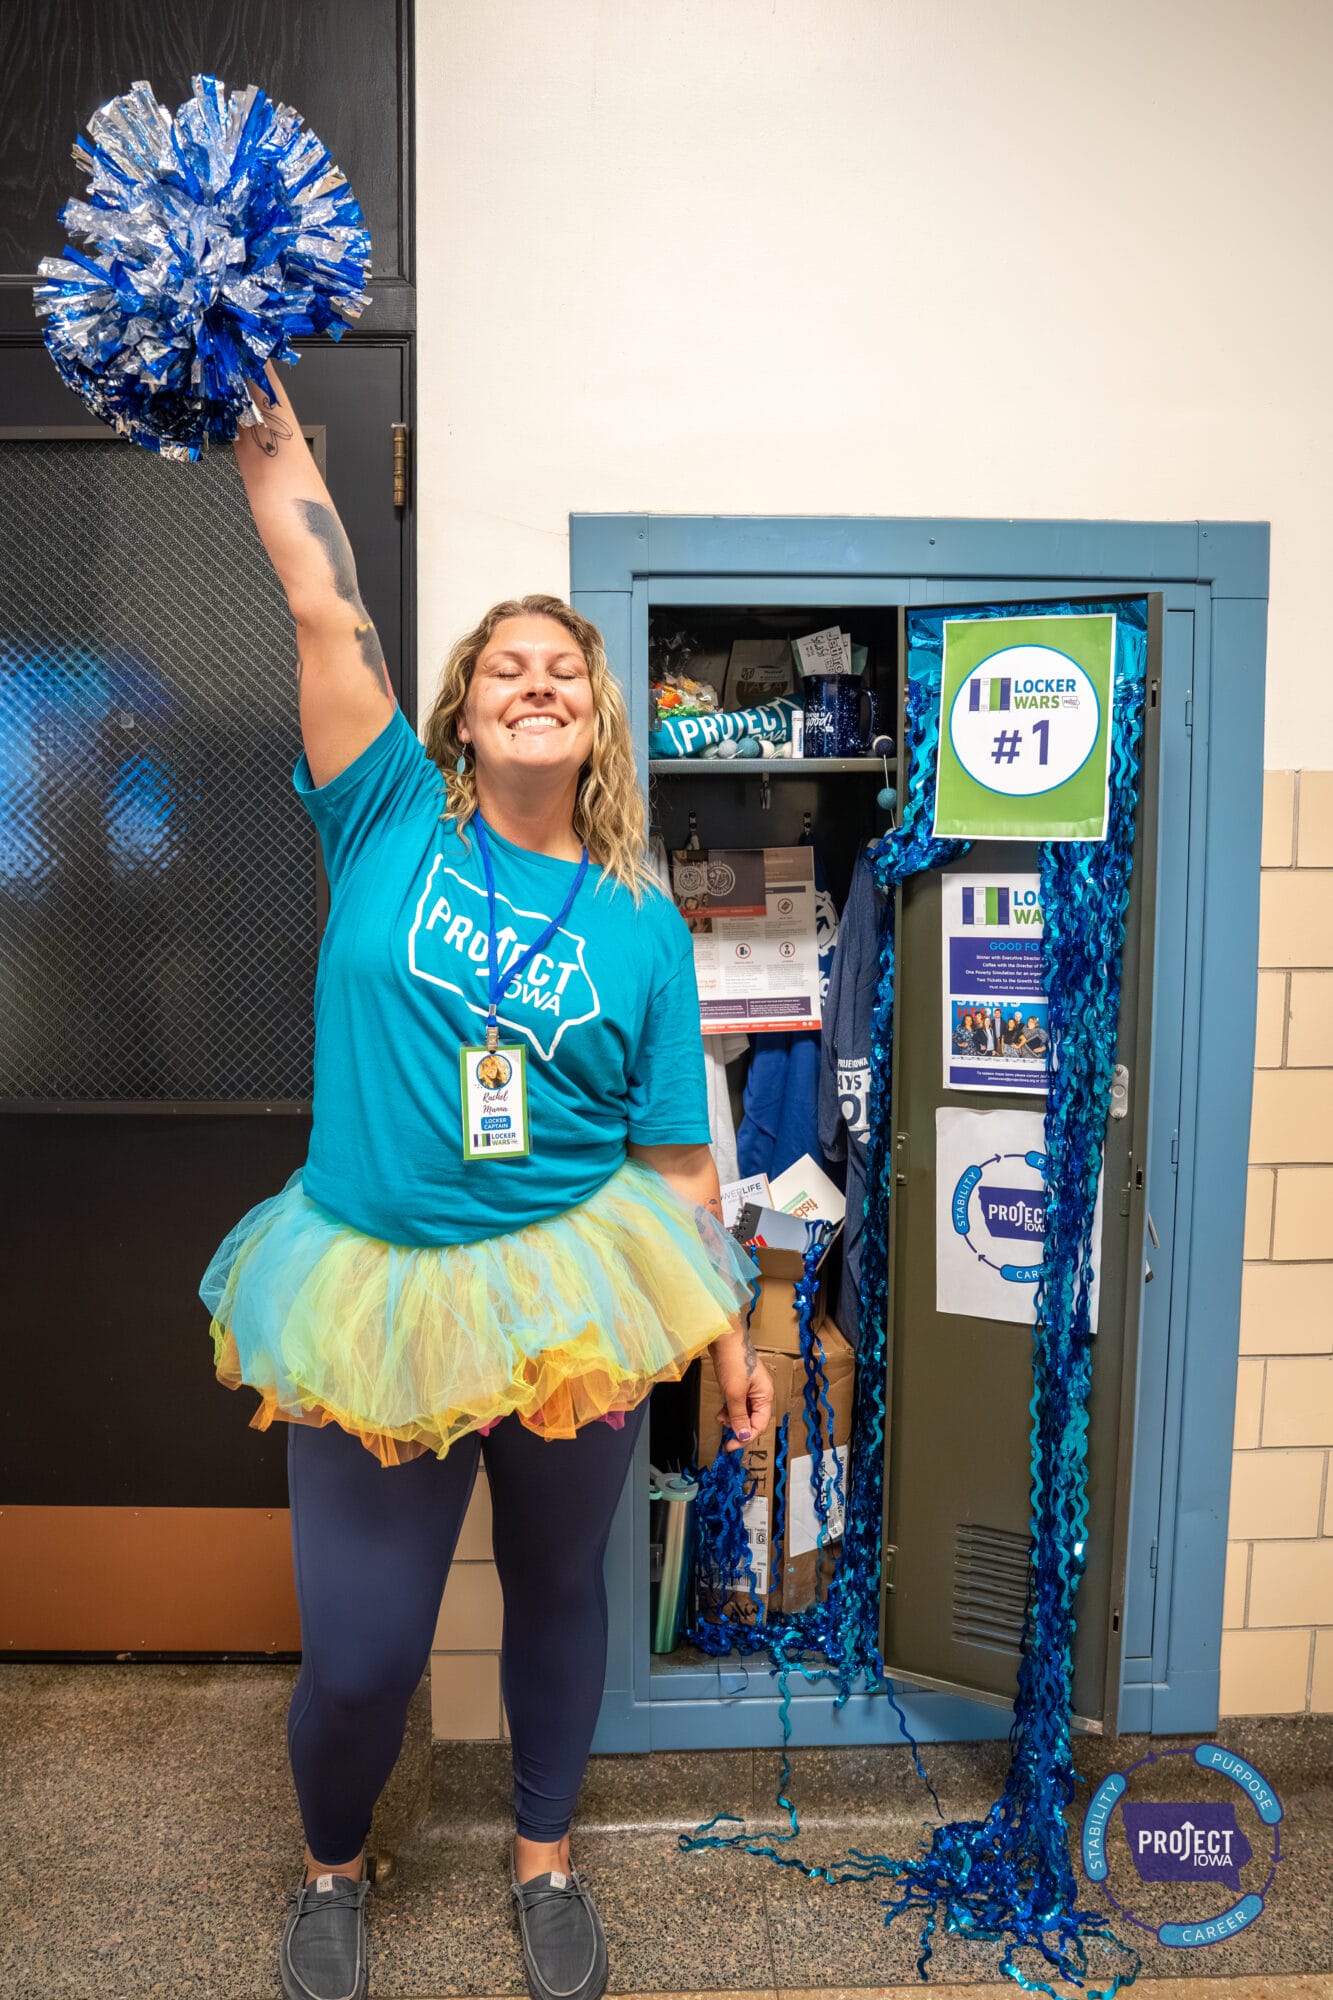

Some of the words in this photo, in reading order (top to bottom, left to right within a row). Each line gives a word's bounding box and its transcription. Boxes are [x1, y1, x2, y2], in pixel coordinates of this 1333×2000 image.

[1014, 678, 1077, 694] LOCKER
[1013, 695, 1060, 710] WARS
[678, 699, 788, 753] PROJECT
[750, 729, 787, 741] OWA
[989, 941, 1023, 952] GOOD
[502, 979, 561, 1017] OWA
[956, 1170, 978, 1227] STABILITY
[988, 1201, 1046, 1227] PROJEC
[1024, 1222, 1046, 1233] IOW
